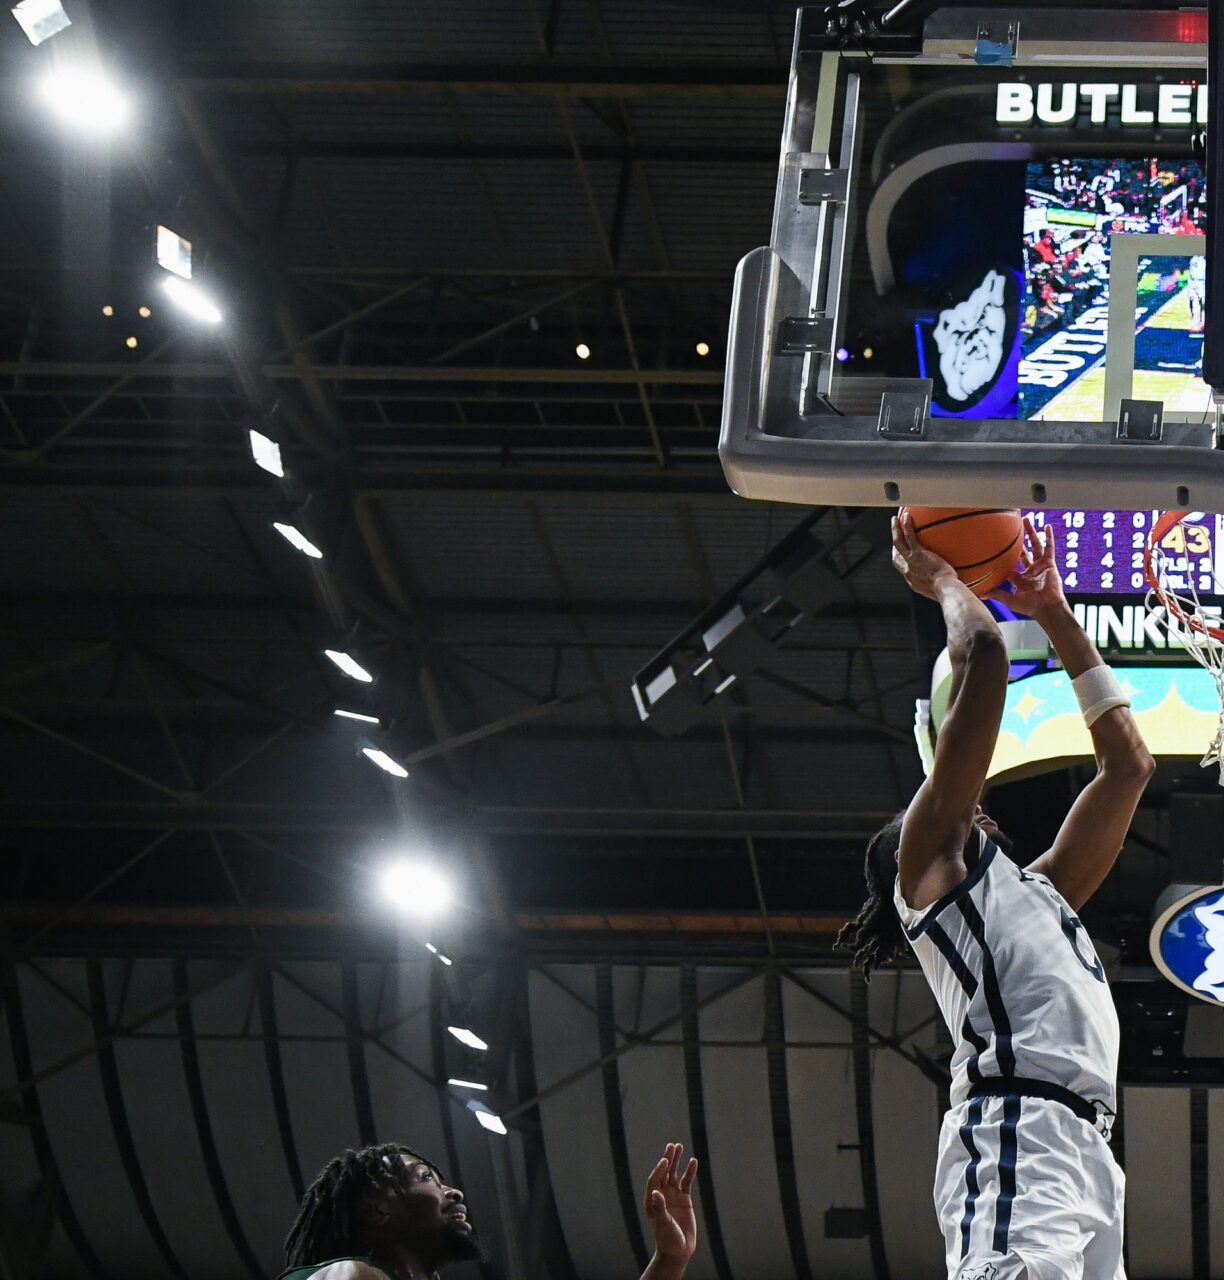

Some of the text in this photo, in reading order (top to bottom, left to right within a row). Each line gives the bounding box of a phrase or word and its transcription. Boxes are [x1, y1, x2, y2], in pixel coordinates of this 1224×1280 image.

[996, 83, 1206, 125] BUTLE
[1103, 512, 1115, 528] 2
[1132, 512, 1145, 528] 0
[1066, 532, 1144, 548] 2 1 2
[1161, 525, 1211, 553] 43
[1066, 552, 1144, 568] 2 4 2
[1064, 572, 1143, 588] 4 2 0
